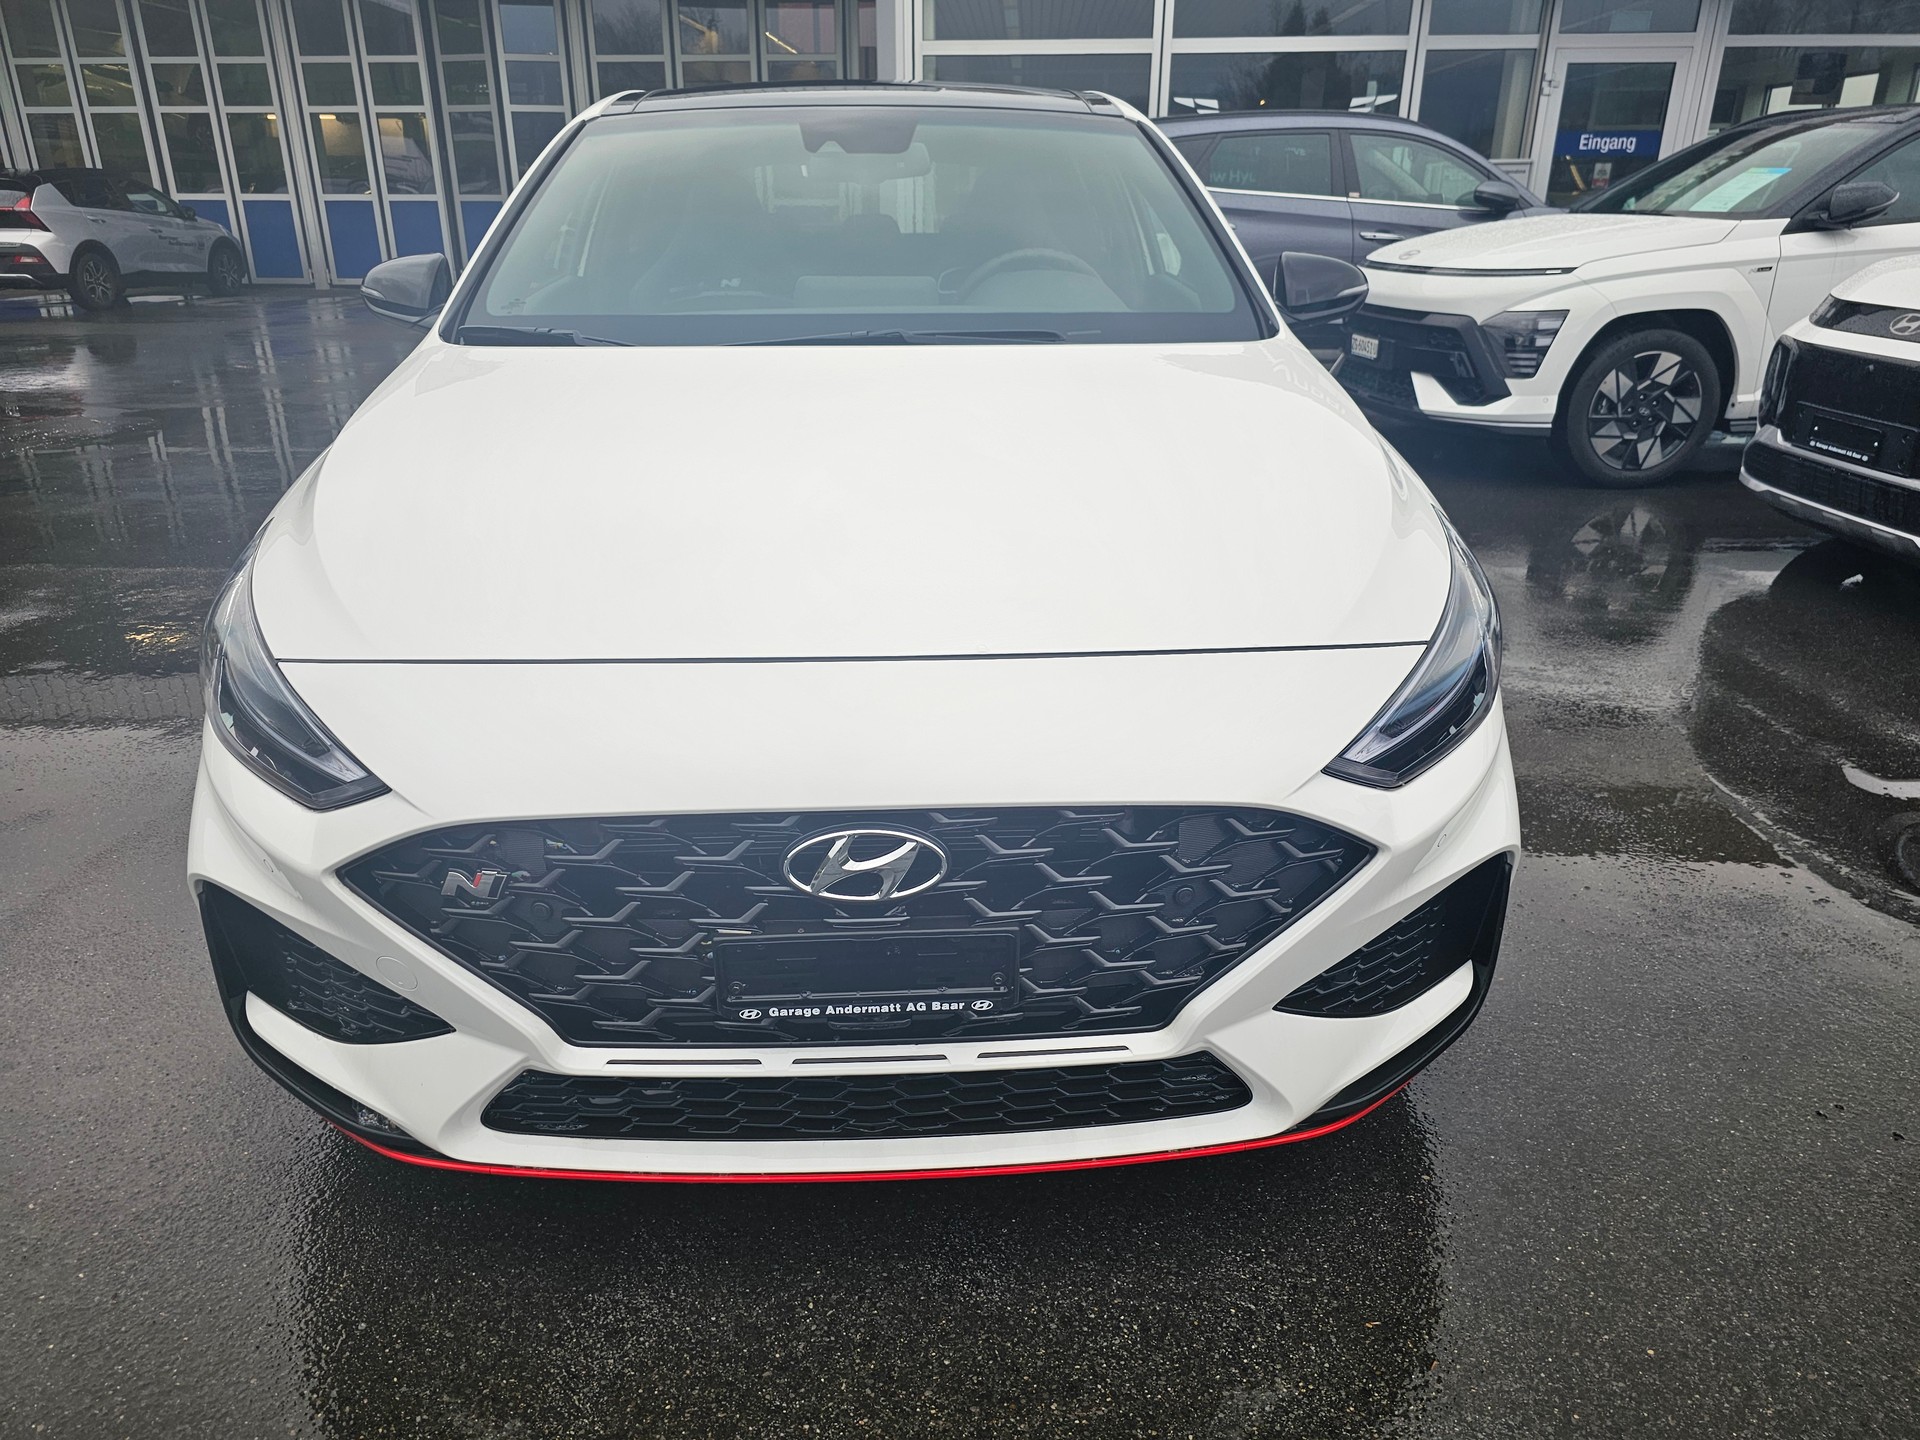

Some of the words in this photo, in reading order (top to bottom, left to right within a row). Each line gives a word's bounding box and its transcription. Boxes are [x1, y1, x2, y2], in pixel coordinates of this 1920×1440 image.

[1579, 134, 1637, 153] Eingang
[441, 871, 507, 899] N
[768, 1007, 820, 1017] Garage
[825, 1003, 901, 1015] Andermatt
[906, 1002, 927, 1011] AG
[931, 1001, 965, 1011] Baar
